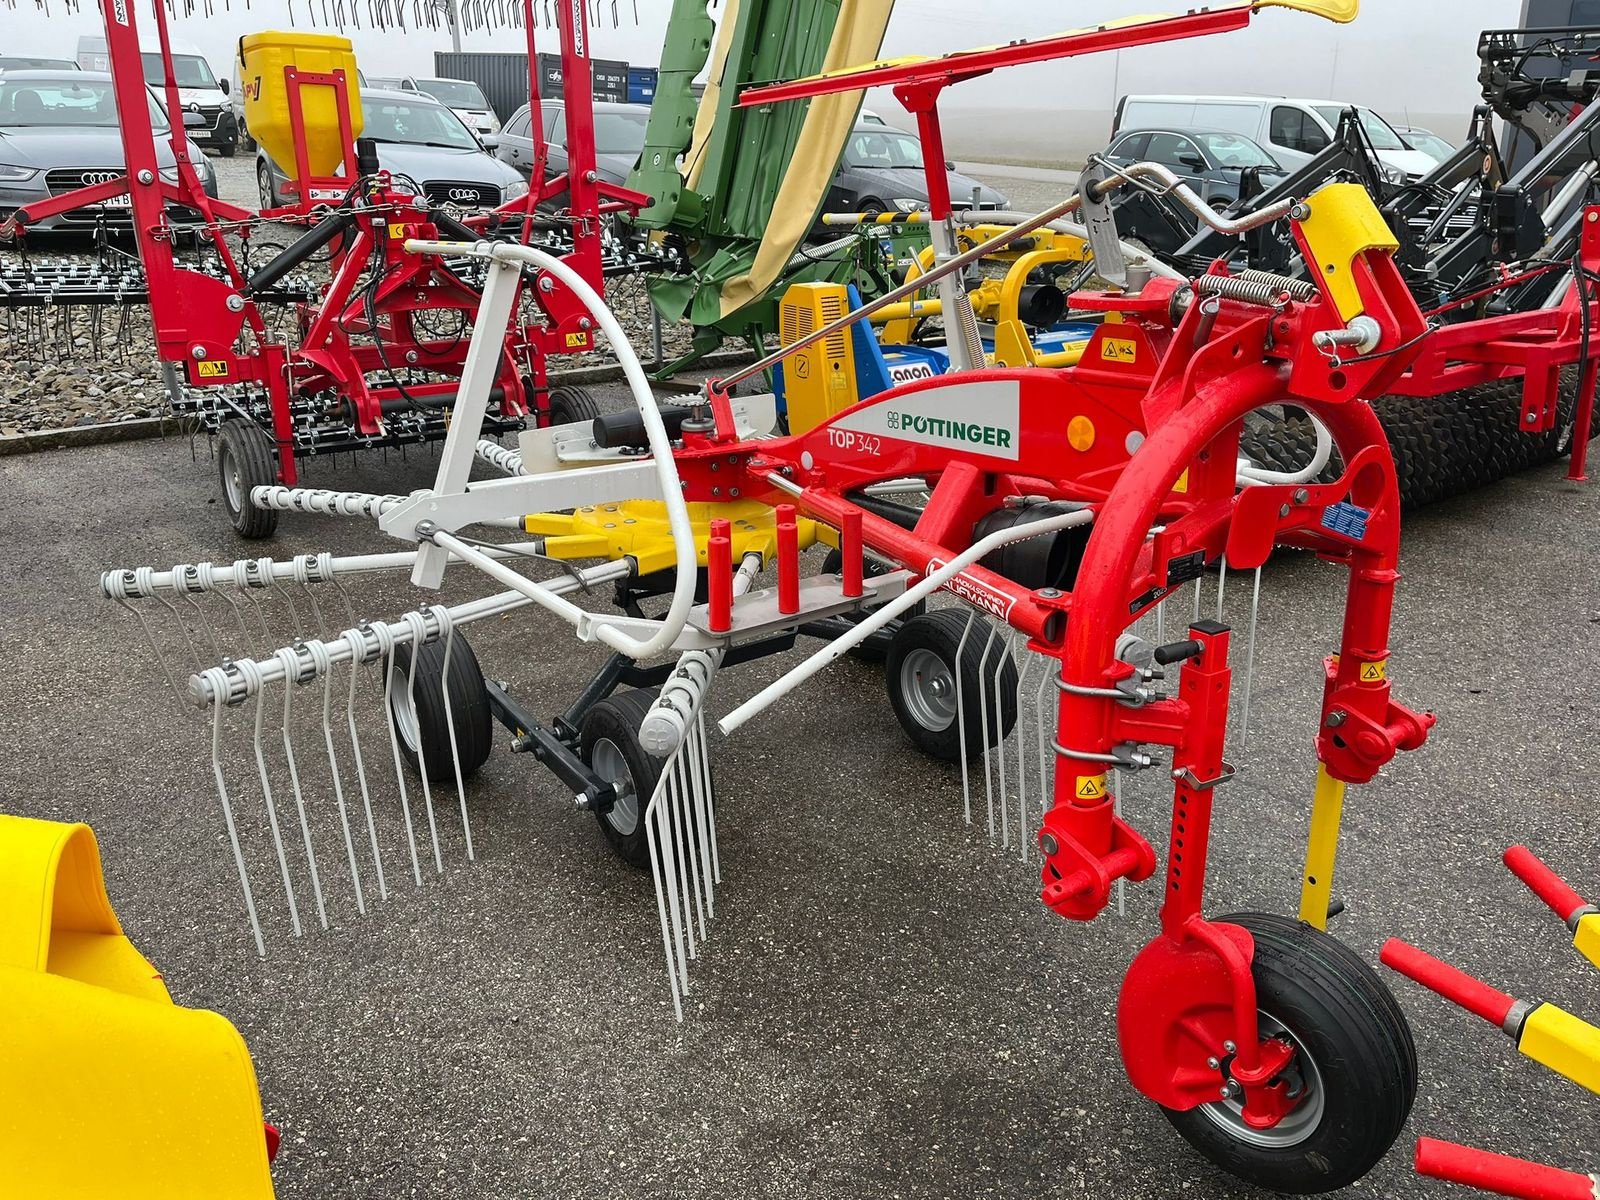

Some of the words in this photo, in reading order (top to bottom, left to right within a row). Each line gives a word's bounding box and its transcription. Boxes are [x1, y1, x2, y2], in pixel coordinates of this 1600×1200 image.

[891, 366, 931, 382] anon
[827, 428, 855, 449] TOP
[857, 434, 881, 456] 342
